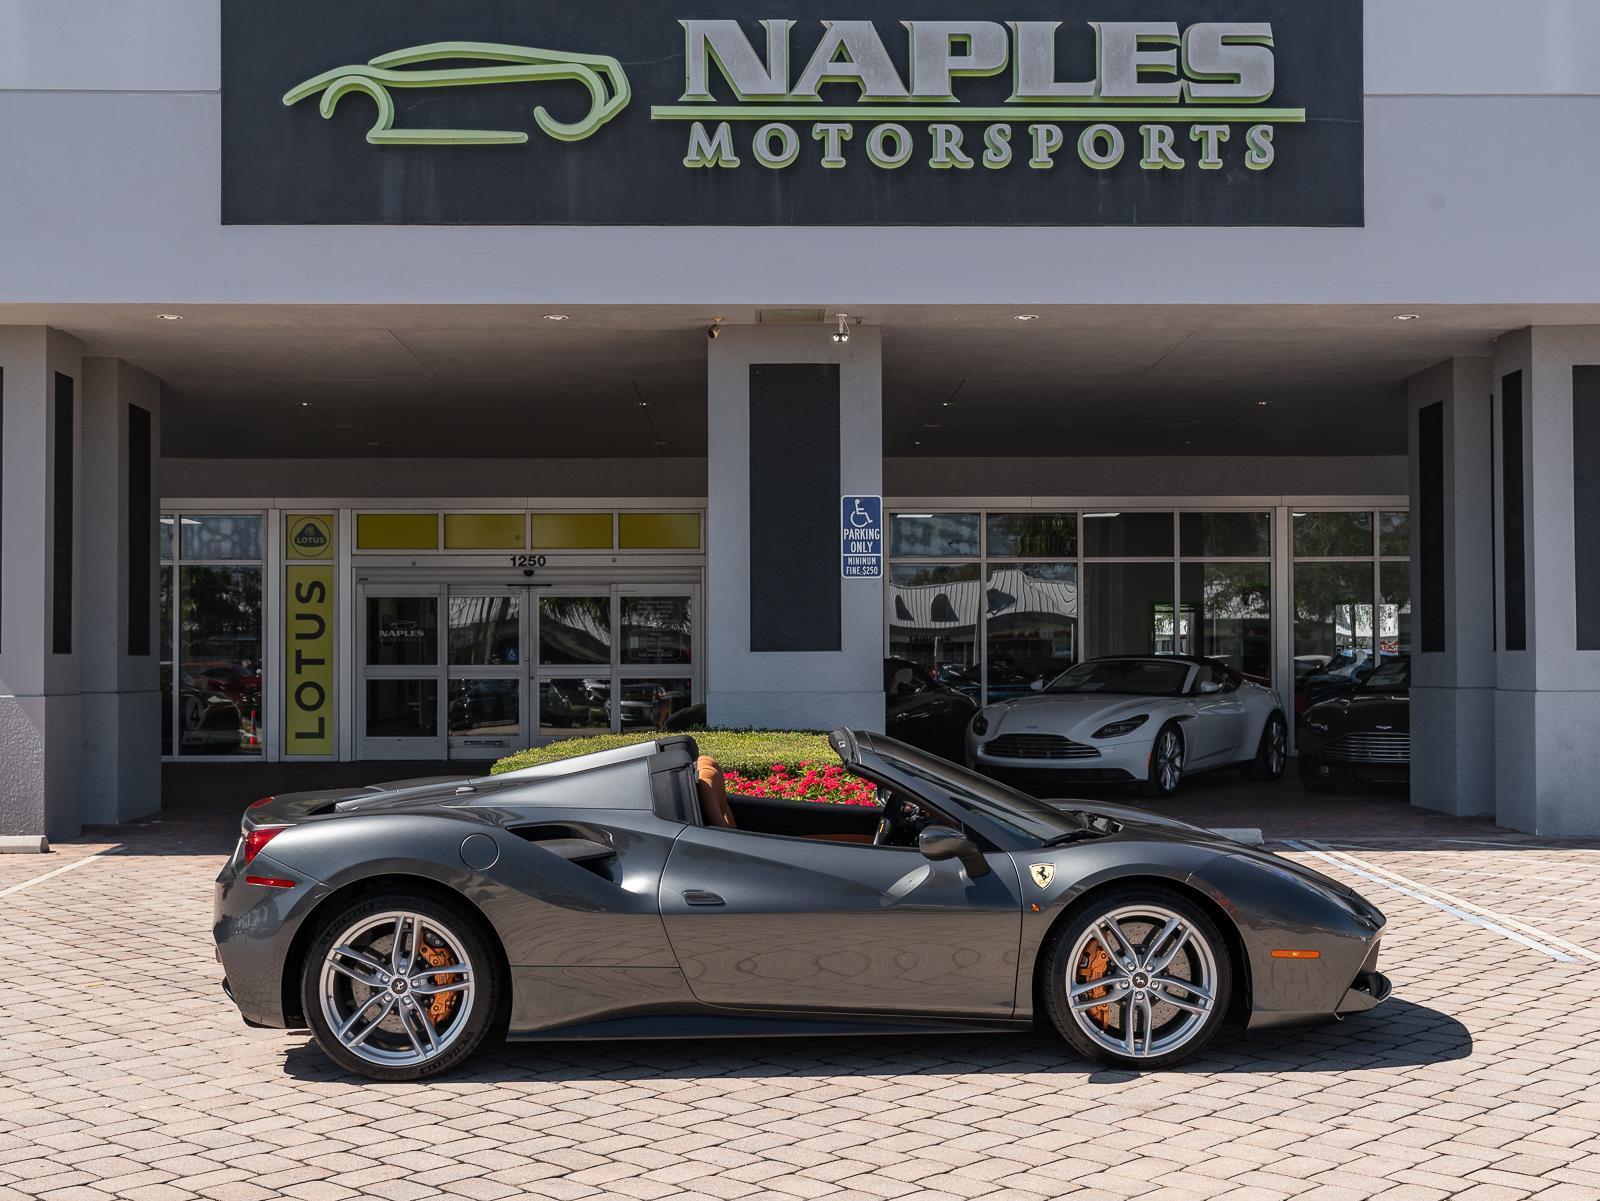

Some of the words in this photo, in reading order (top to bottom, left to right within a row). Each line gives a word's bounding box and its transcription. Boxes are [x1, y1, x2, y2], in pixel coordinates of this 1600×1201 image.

[678, 19, 1275, 103] NAPLES
[682, 121, 1275, 171] MOTORSPORTS
[296, 536, 325, 544] LOTUS
[844, 528, 880, 540] PARKING
[850, 542, 873, 552] ONLY
[510, 555, 547, 567] 1250
[846, 566, 860, 574] FINE
[862, 566, 878, 575] $250
[294, 580, 326, 739] LOTUS
